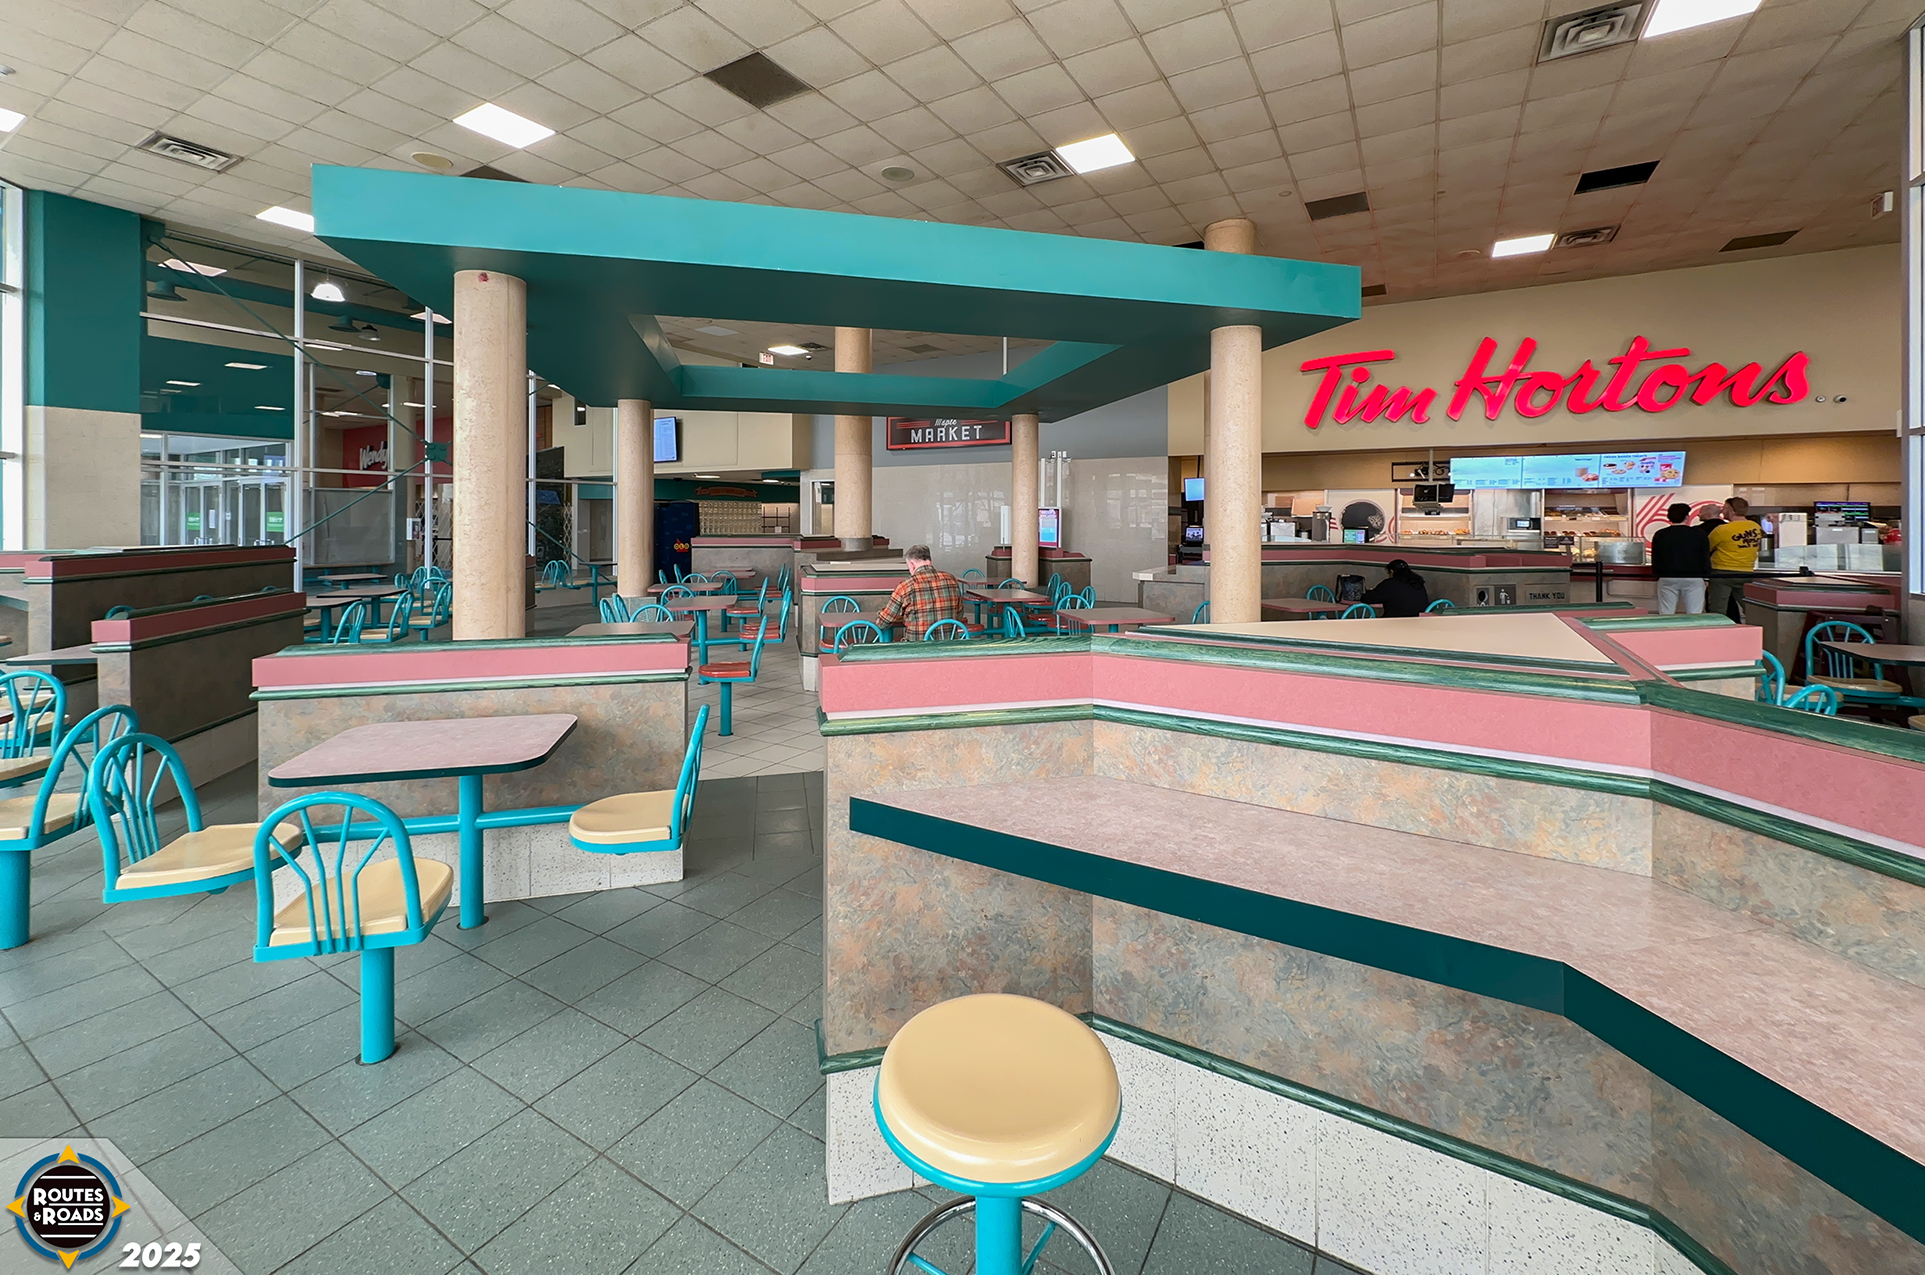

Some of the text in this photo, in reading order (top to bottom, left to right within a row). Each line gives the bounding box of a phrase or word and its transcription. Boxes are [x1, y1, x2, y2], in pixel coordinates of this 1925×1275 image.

[1300, 335, 1810, 429] Tim Hortons
[934, 418, 957, 429] Maple
[911, 425, 982, 443] MARKET
[1529, 592, 1565, 600] THANK YOU
